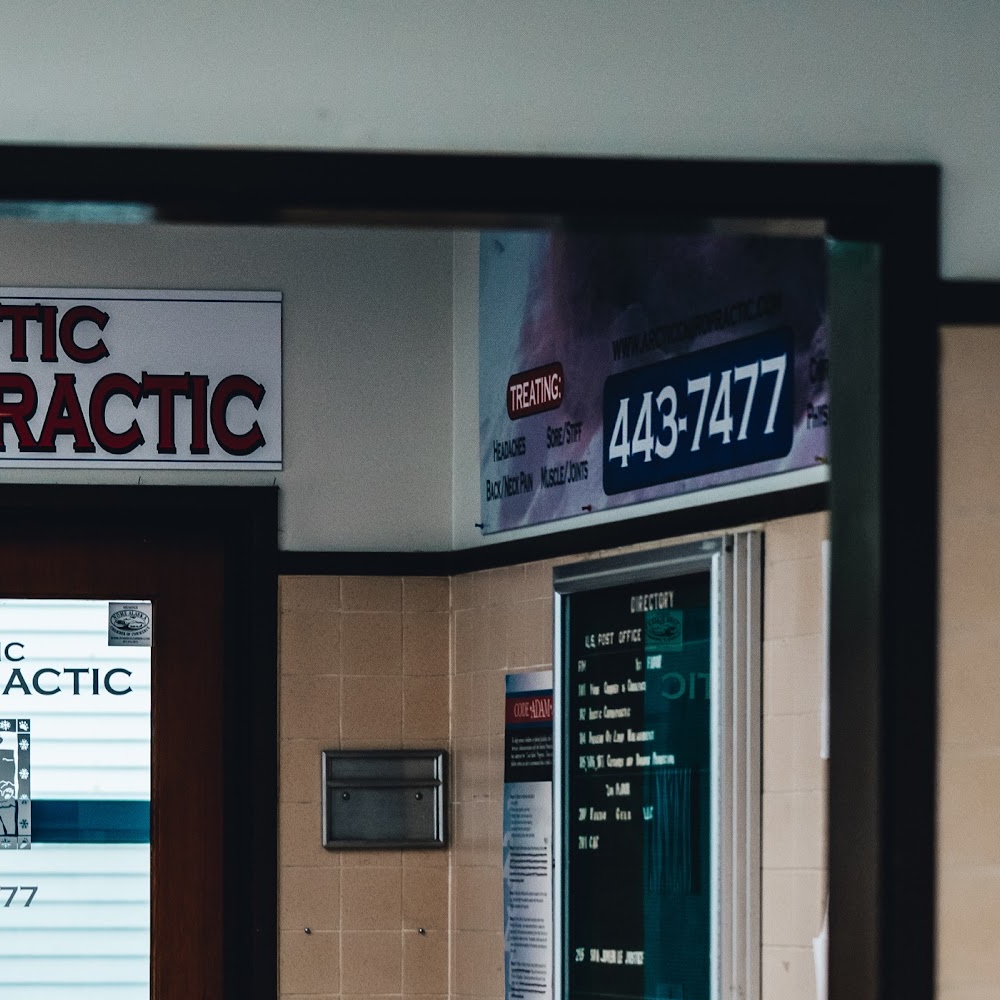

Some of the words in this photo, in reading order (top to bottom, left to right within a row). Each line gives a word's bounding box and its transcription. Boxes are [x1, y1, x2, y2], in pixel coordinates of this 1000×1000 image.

[510, 372, 562, 412] TREATING:
[608, 353, 787, 468] 443-7477
[493, 436, 526, 463] HEADACHES
[630, 591, 674, 614] DIRECTORY
[598, 632, 614, 646] POST
[618, 628, 642, 644] OFFICE
